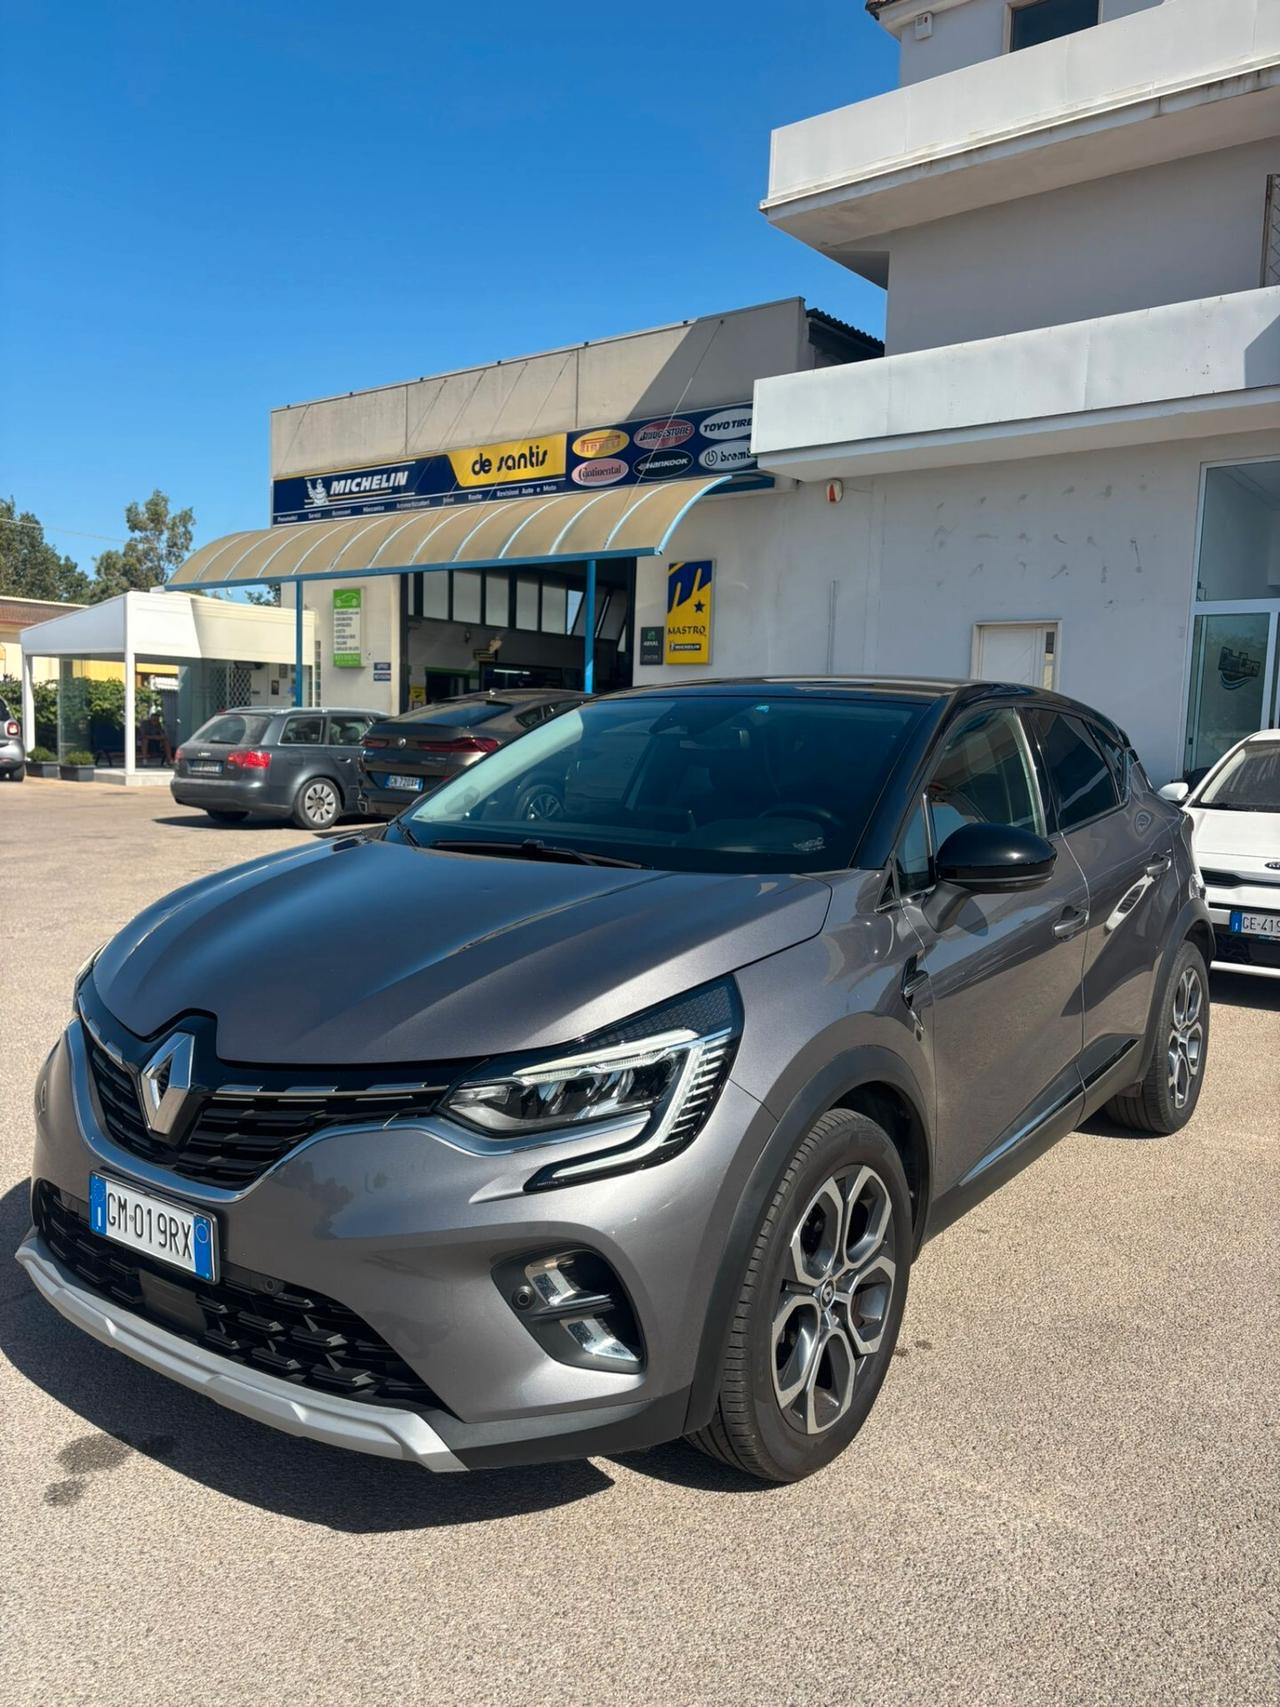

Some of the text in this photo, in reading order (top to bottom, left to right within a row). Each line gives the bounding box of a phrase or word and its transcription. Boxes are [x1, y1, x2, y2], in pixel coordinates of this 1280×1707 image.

[704, 417, 753, 433] TOYO TIRE
[471, 445, 548, 476] de santis
[720, 448, 752, 463] bremb
[579, 465, 622, 481] Continental
[330, 471, 408, 495] MICHELIN
[668, 626, 706, 635] MASTRO
